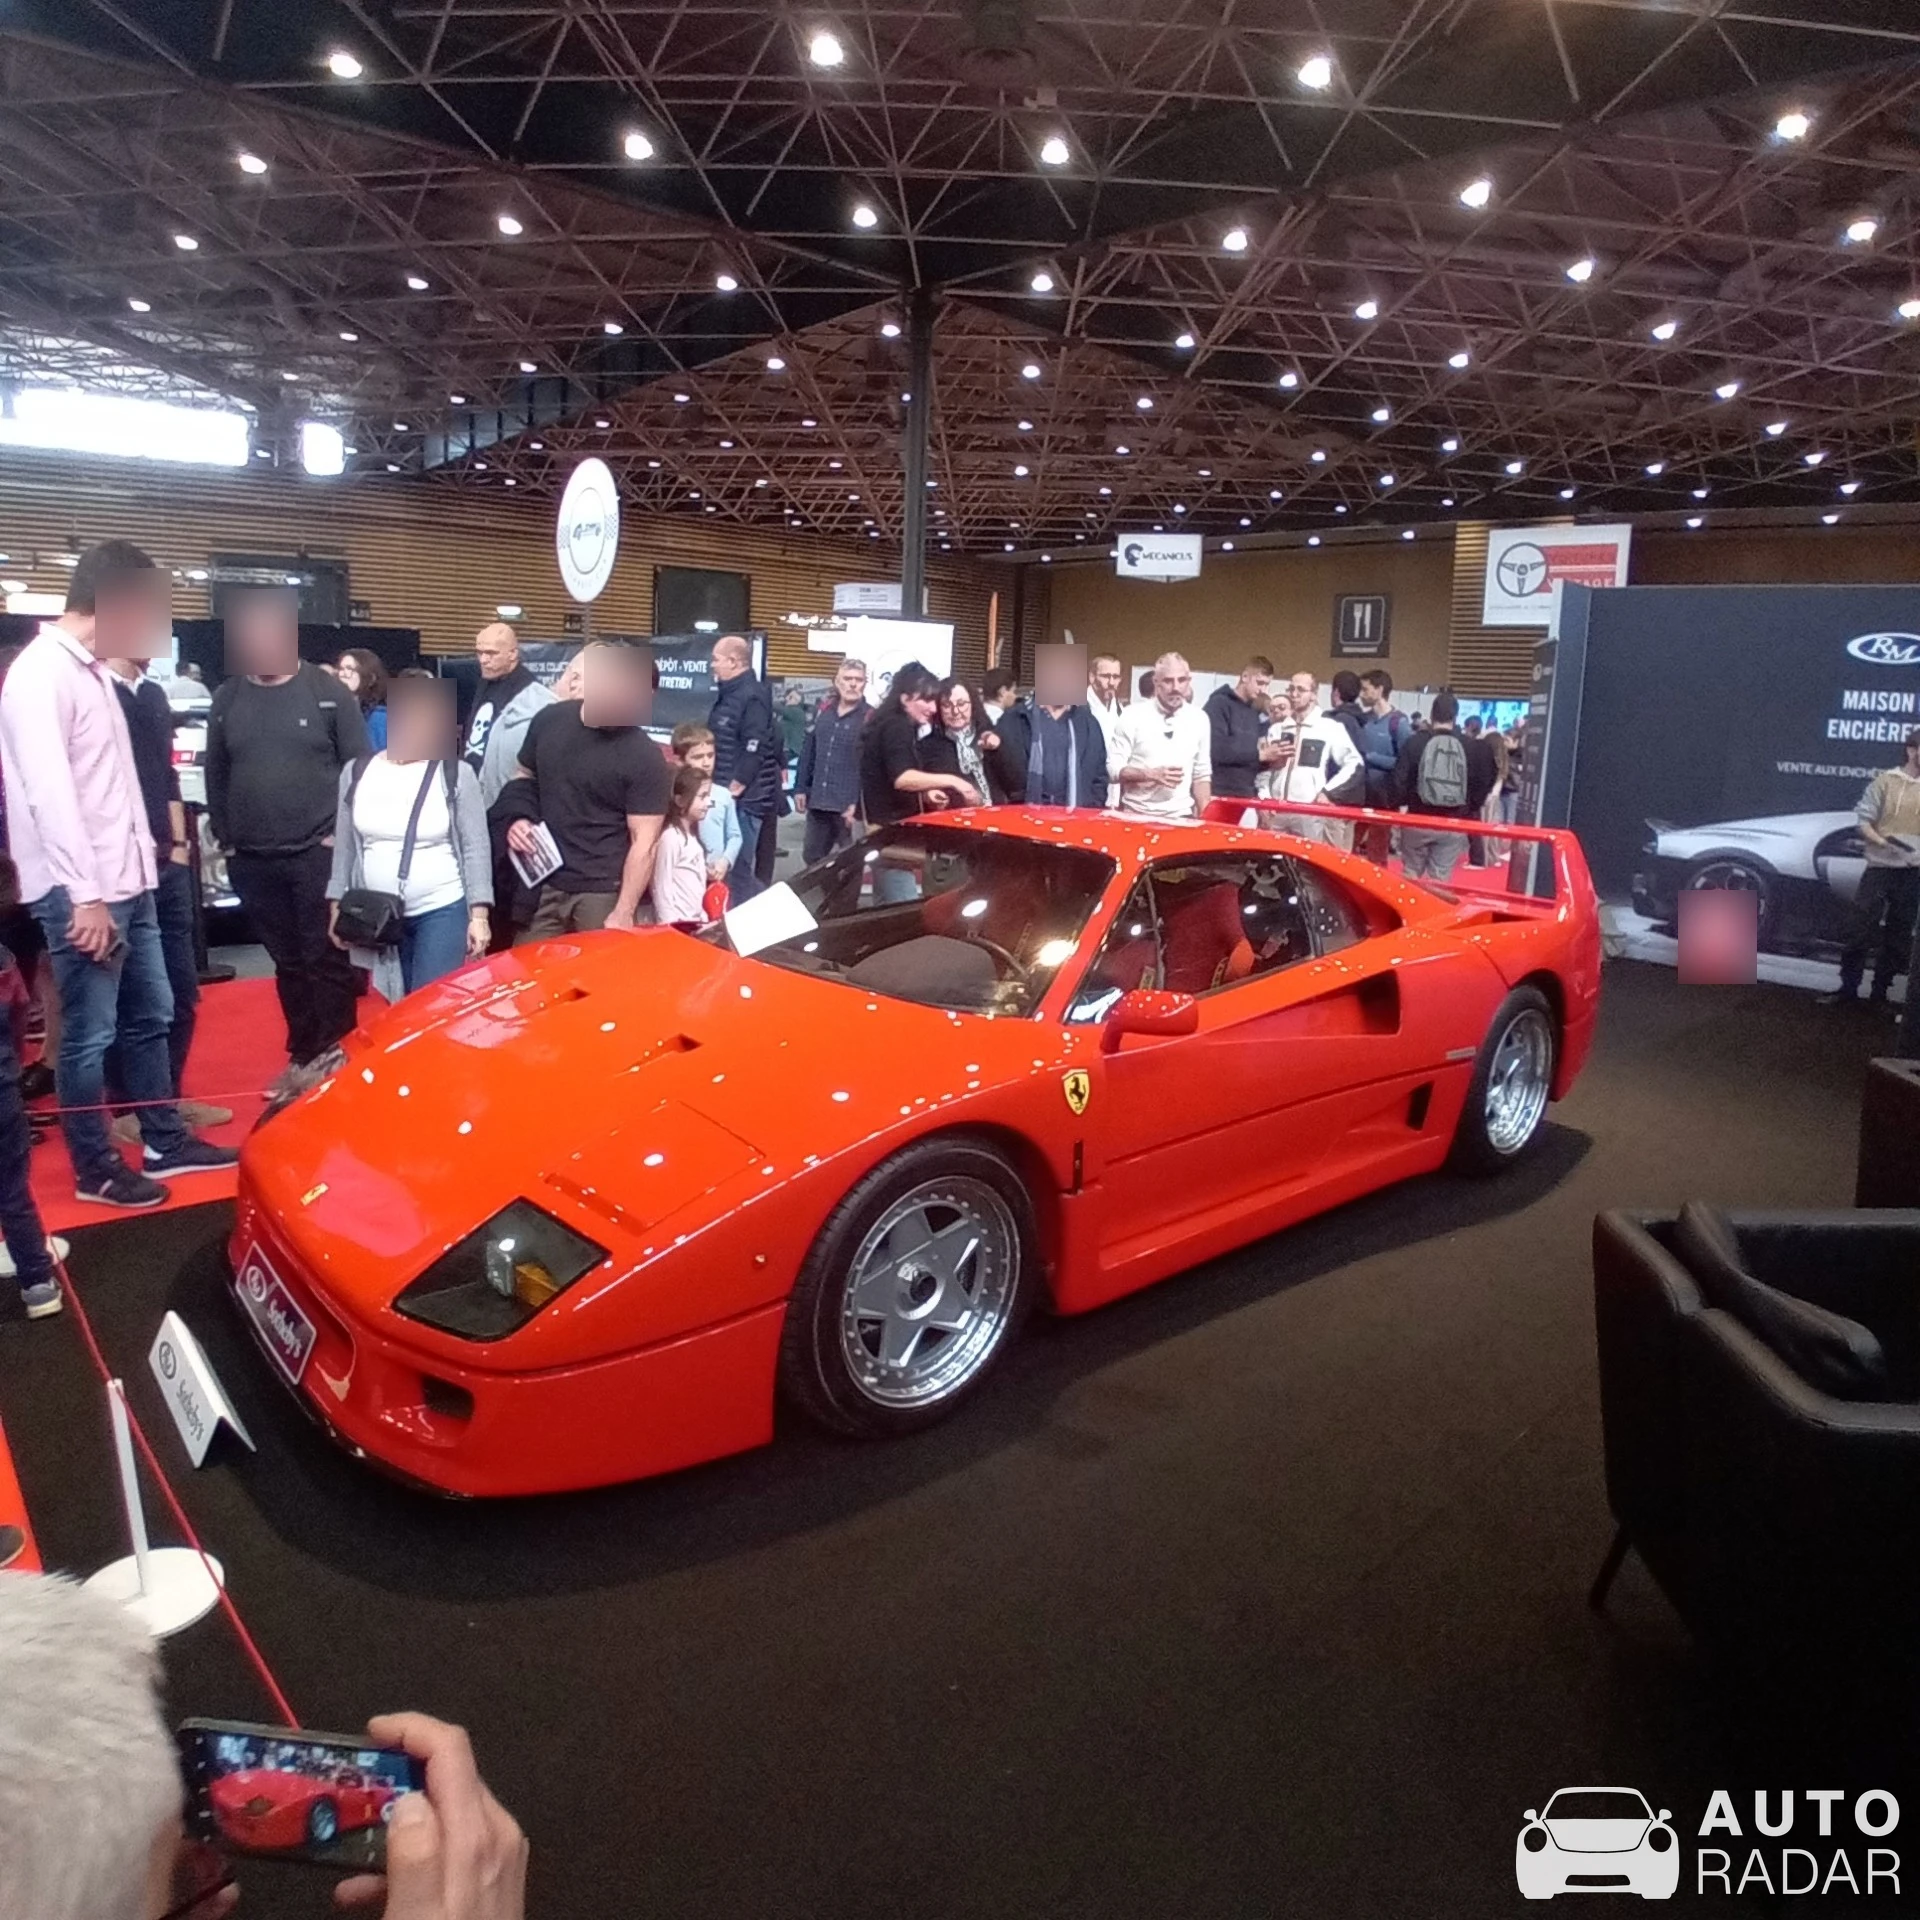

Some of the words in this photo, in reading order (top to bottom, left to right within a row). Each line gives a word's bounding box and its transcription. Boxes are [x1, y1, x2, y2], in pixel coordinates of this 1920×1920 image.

[1142, 551, 1193, 561] MECANICUS
[682, 660, 708, 673] VENTE
[1842, 689, 1916, 713] MAISON
[1776, 761, 1813, 774] VENTE
[1814, 764, 1837, 776] AUX
[267, 1298, 302, 1359] Sotheby's
[176, 1378, 204, 1442] Sotheby's
